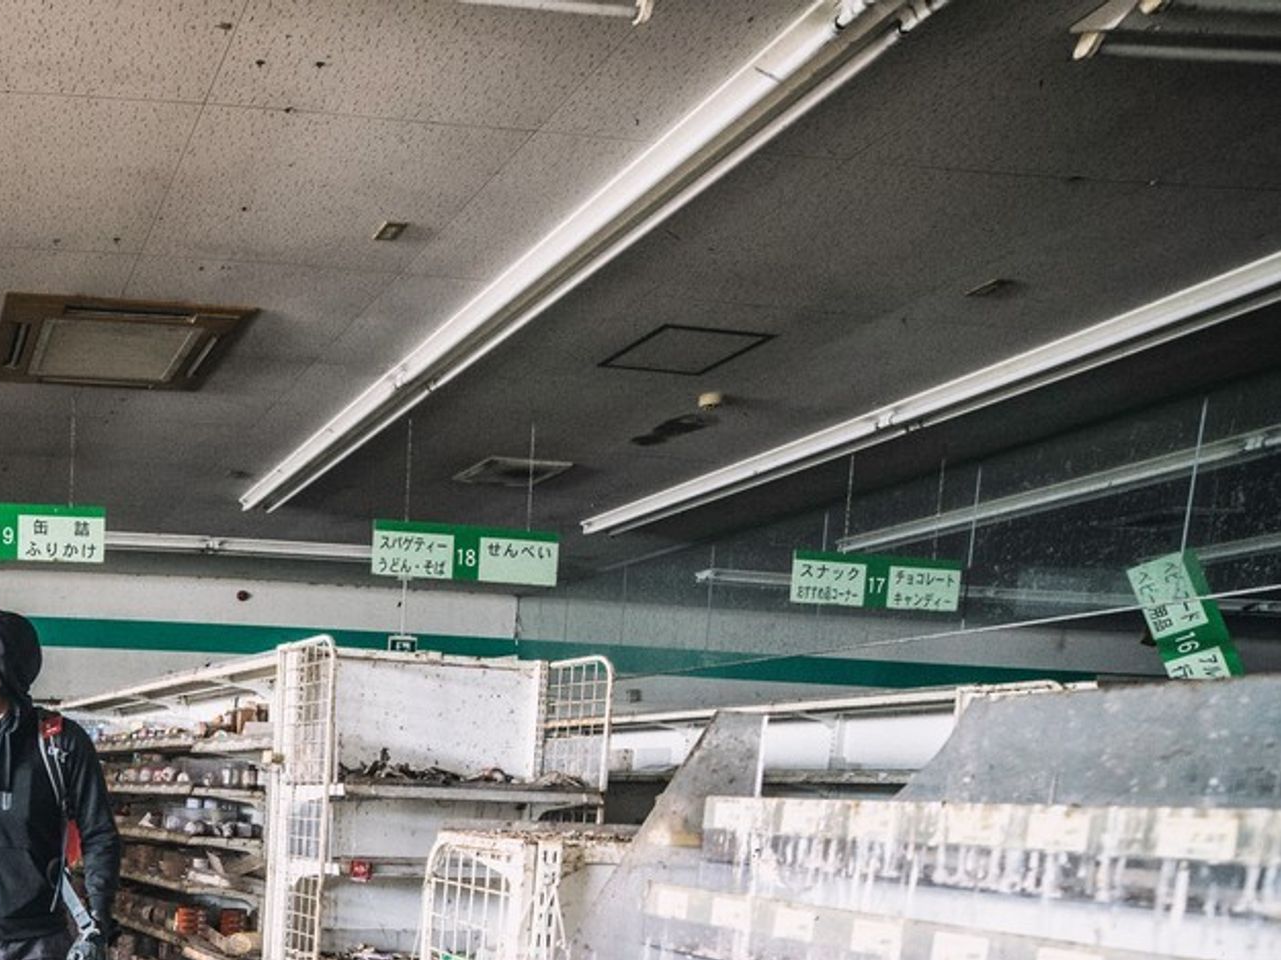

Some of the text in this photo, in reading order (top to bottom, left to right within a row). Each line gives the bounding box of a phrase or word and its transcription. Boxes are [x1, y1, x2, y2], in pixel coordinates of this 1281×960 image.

[32, 519, 91, 537] 缶詰
[24, 541, 97, 559] ふりかけ
[378, 534, 448, 552] スパゲティー
[487, 542, 553, 560] せんべい
[377, 556, 447, 576] うどん・そば
[456, 548, 477, 568] 18
[799, 563, 860, 582] スナック
[894, 570, 956, 588] チョコレート
[868, 577, 887, 594] 17
[892, 592, 953, 608] キャンディー
[1174, 631, 1200, 654] 16
